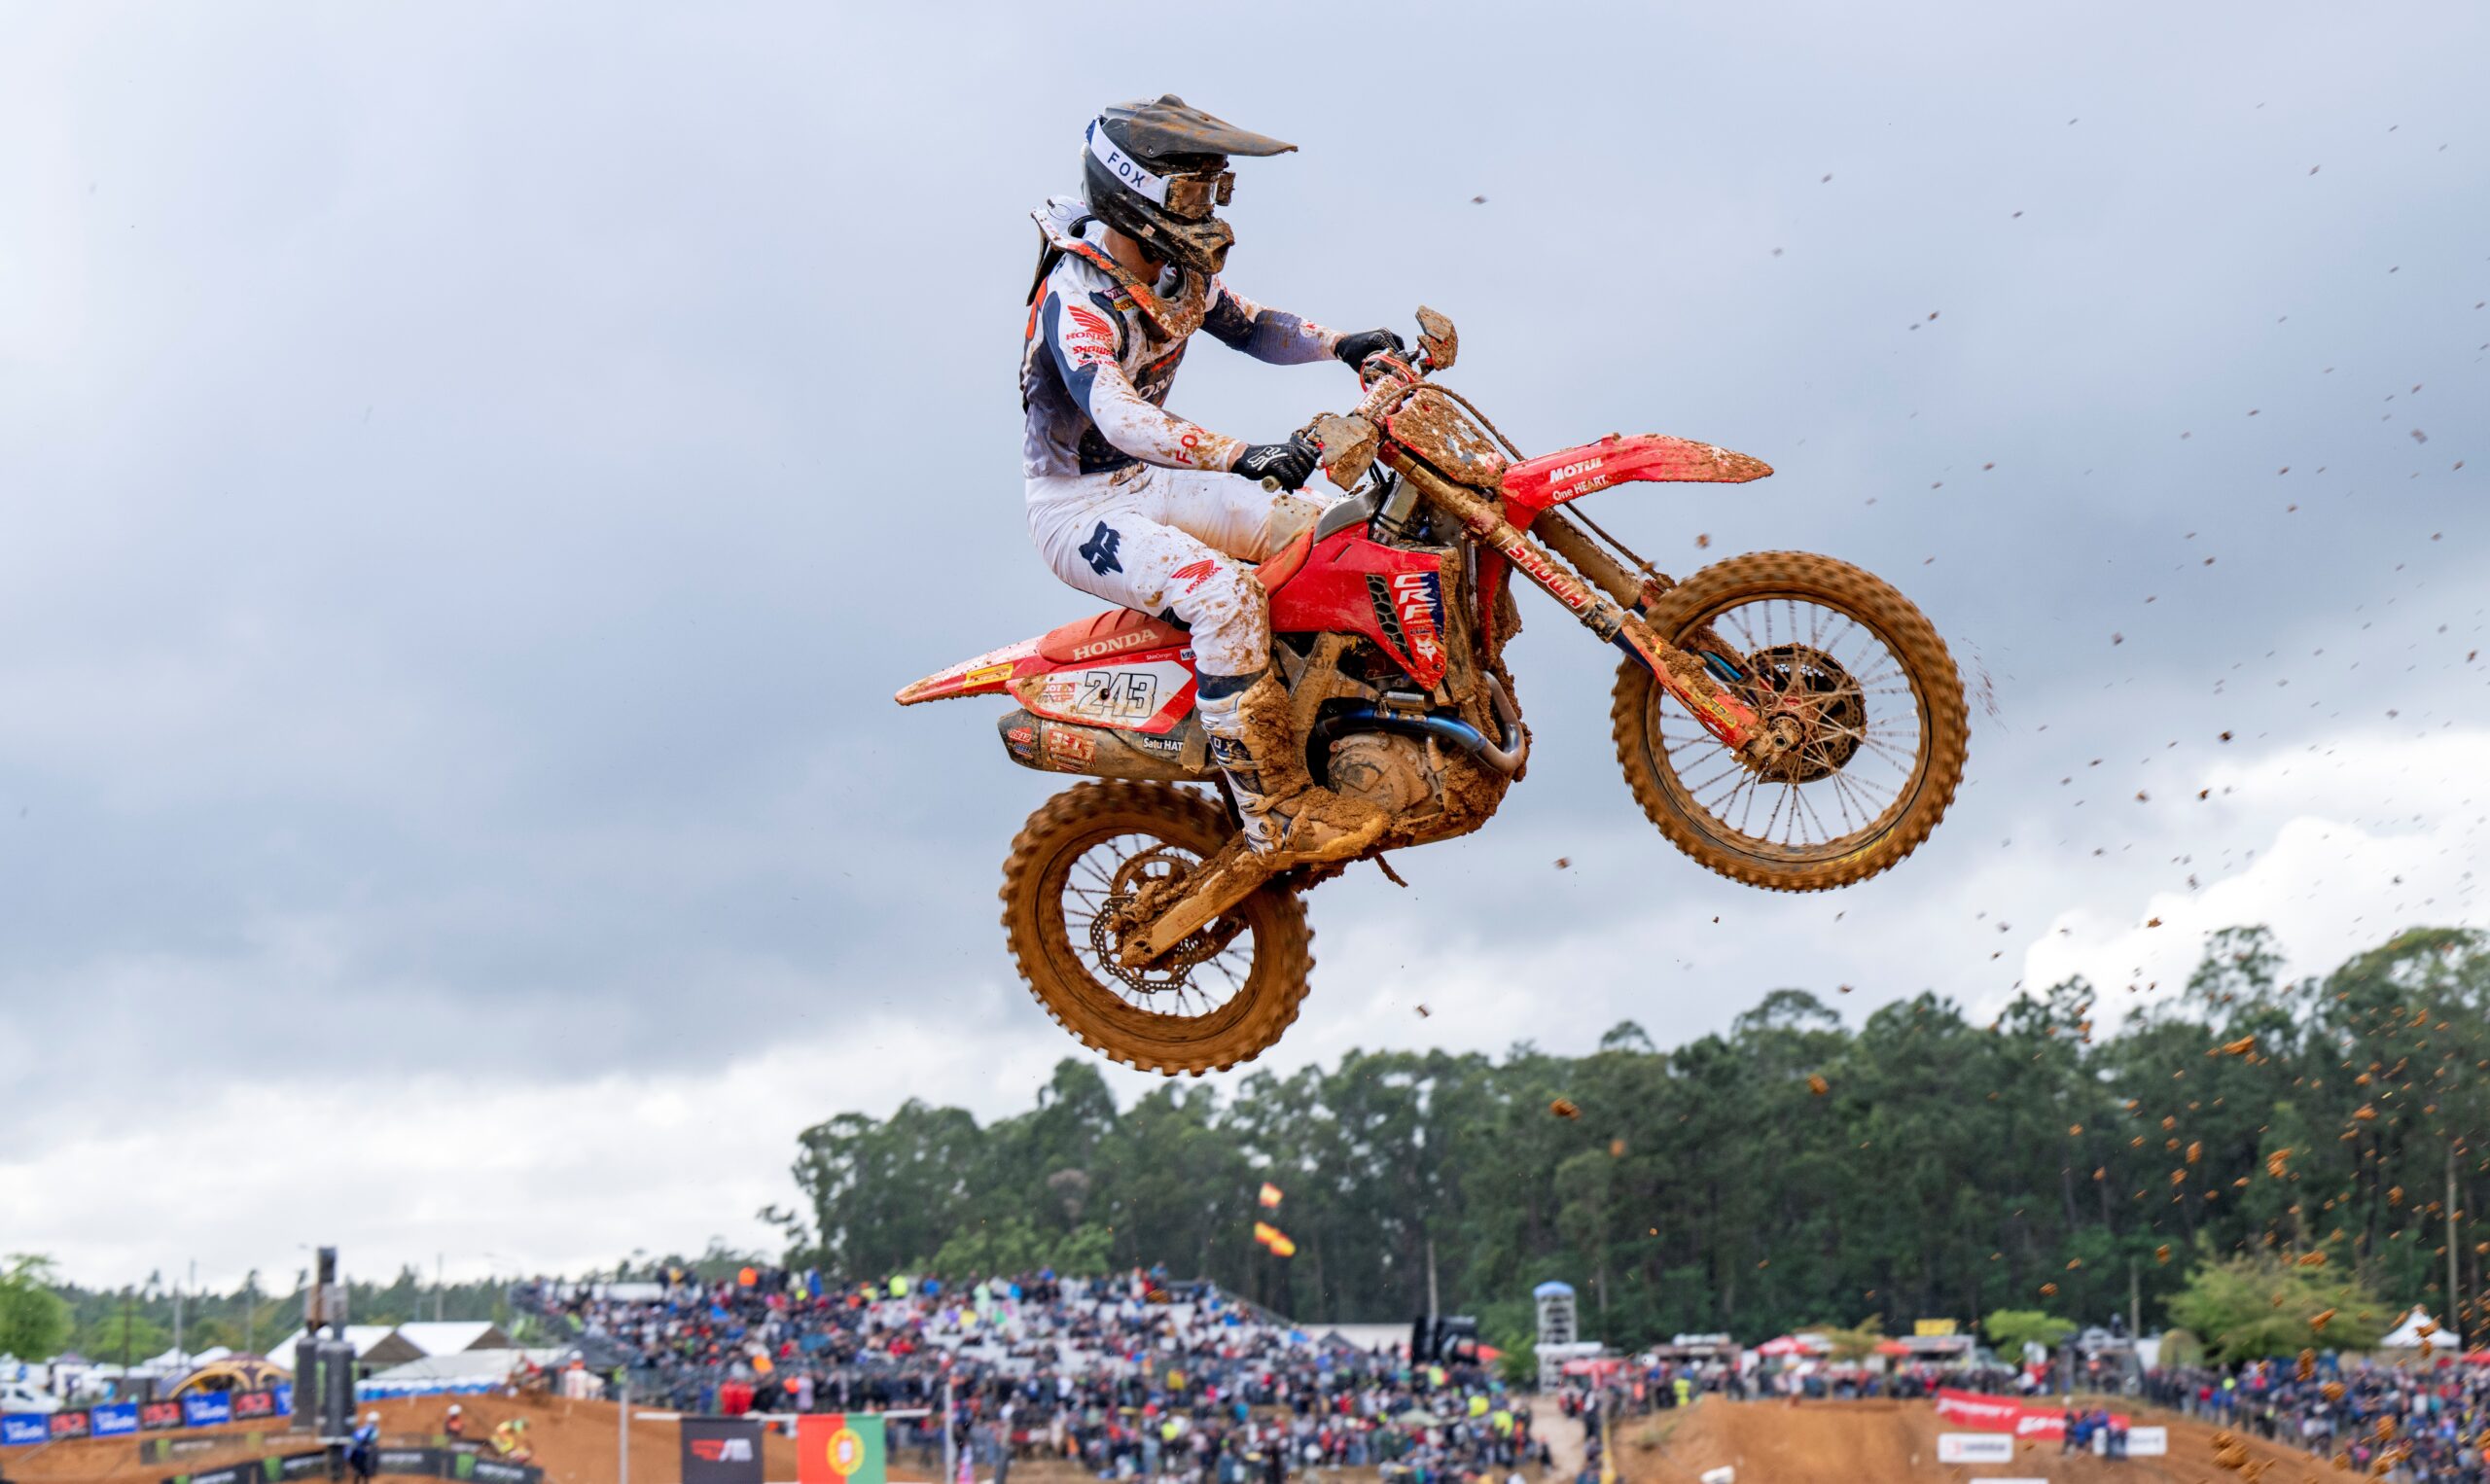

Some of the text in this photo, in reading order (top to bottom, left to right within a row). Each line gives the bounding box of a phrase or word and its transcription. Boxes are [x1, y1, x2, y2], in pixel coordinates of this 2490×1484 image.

[1107, 151, 1146, 188] FOX
[1176, 426, 1205, 465] FOX
[1549, 457, 1604, 483] MOTUL
[1552, 488, 1574, 501] One
[1185, 566, 1224, 594] HONDA
[1505, 541, 1589, 609] SHOWA
[1393, 572, 1438, 621] CRF
[1073, 628, 1158, 661] HONDA
[1076, 671, 1157, 719] 243
[1143, 737, 1184, 752] Satu HAT
